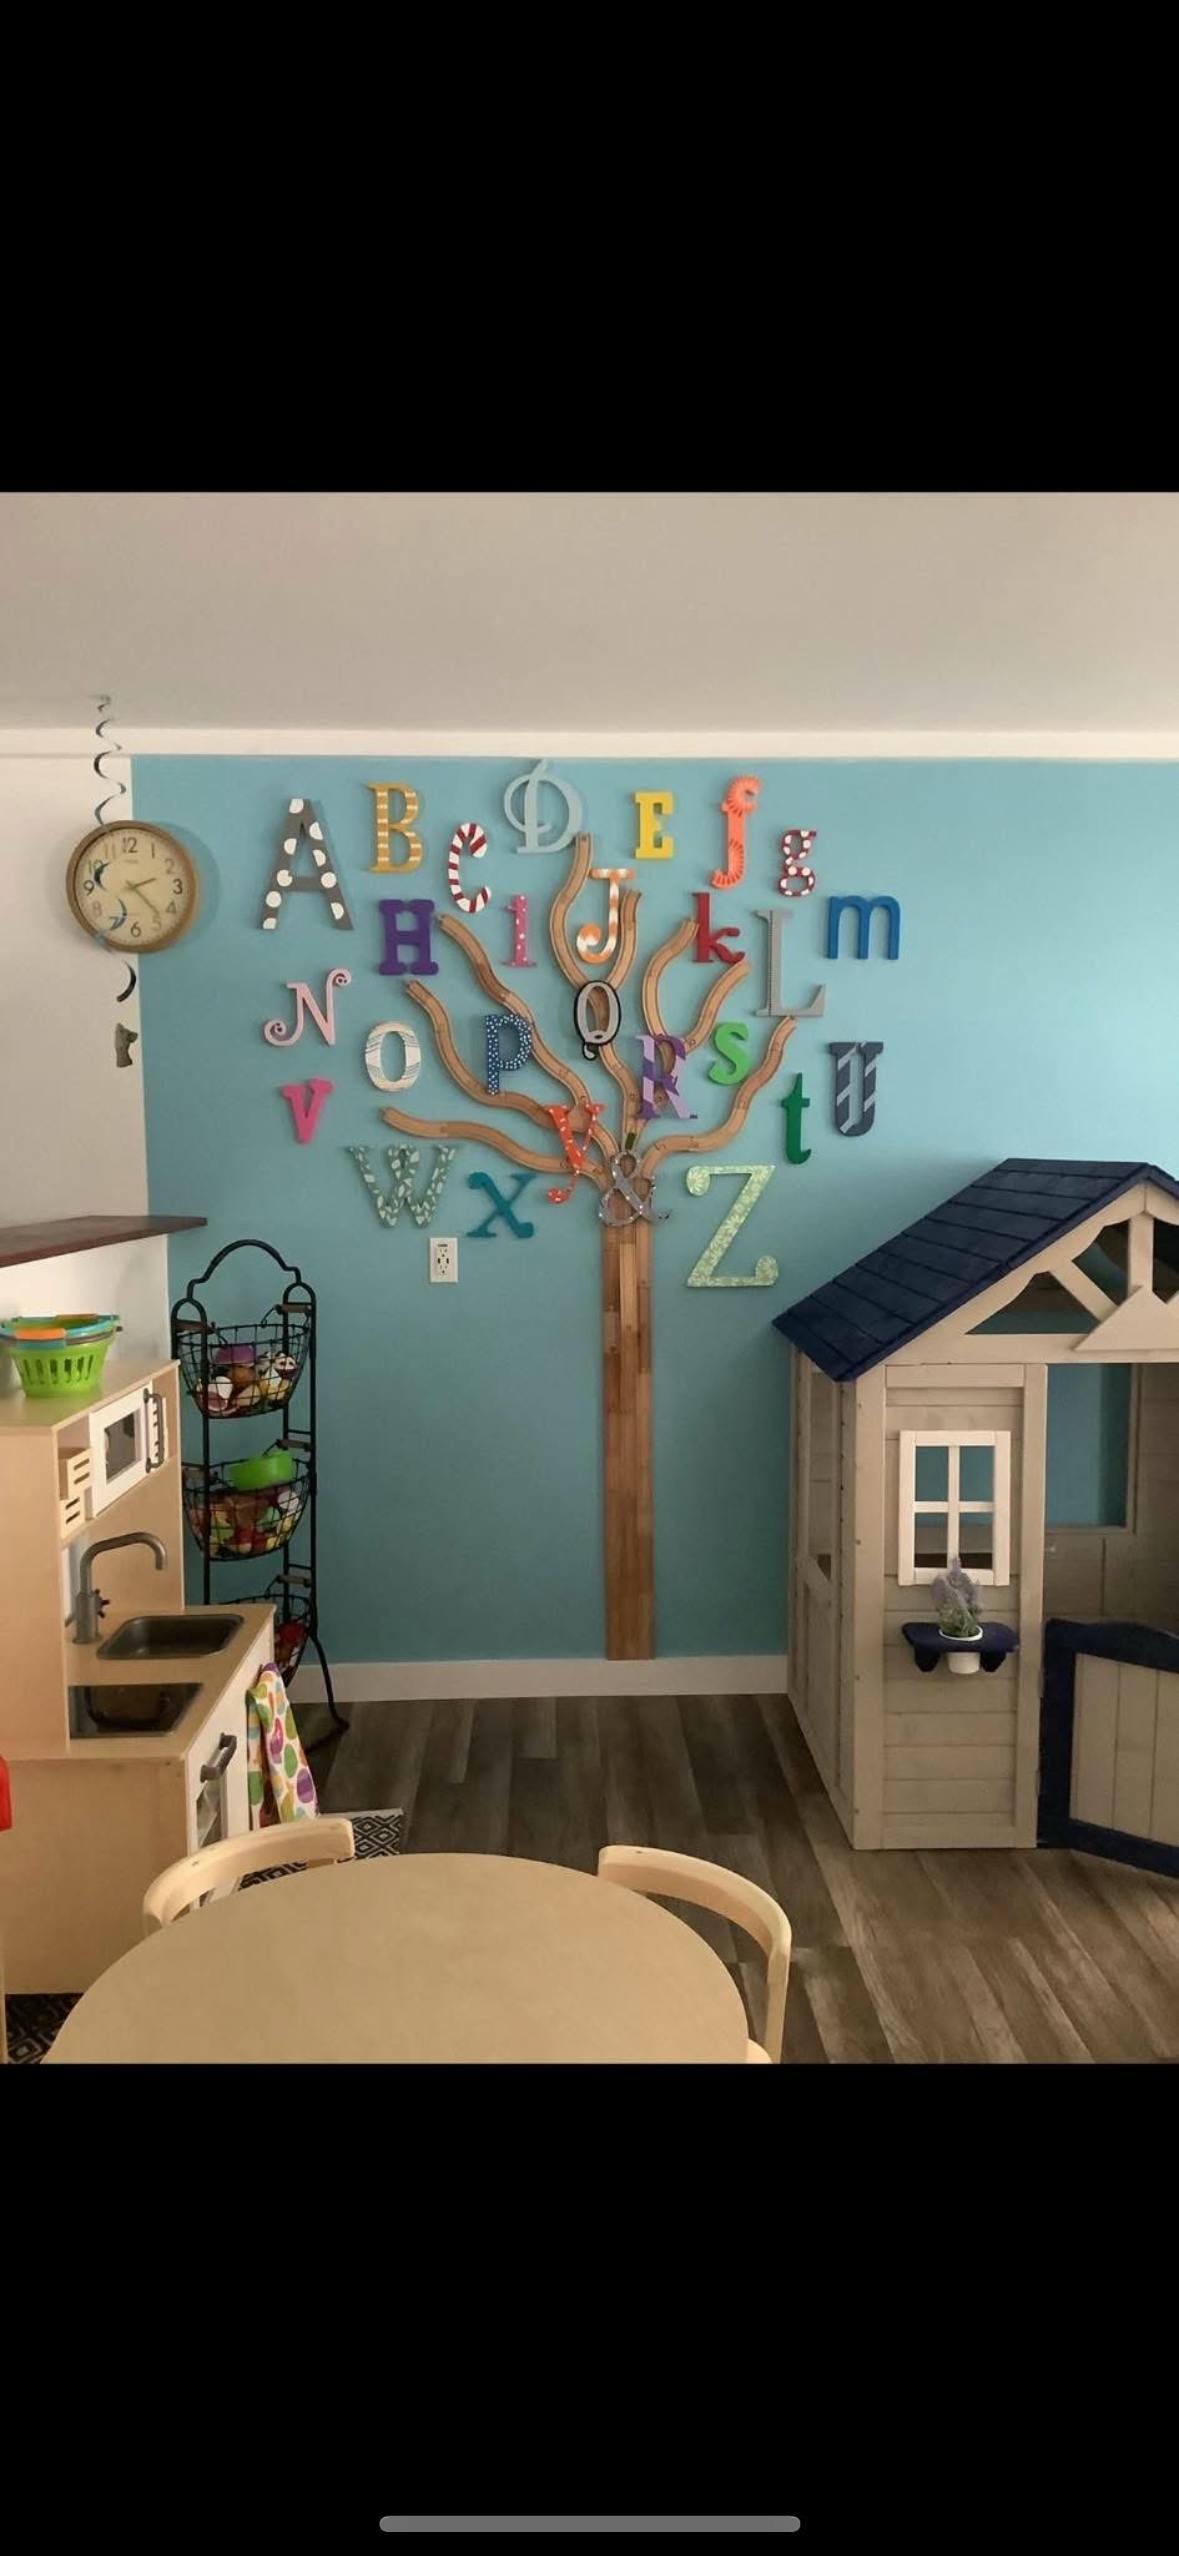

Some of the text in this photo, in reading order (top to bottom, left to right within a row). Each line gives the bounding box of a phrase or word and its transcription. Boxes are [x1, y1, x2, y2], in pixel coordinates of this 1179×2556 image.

[367, 782, 424, 873] B
[503, 759, 583, 854] D
[634, 791, 674, 859] E
[123, 837, 138, 853] 12
[164, 858, 175, 875] 2
[261, 798, 354, 930] A
[447, 822, 491, 913] C
[777, 828, 817, 897] g
[84, 880, 95, 896] 9
[165, 900, 177, 914] 4
[173, 878, 183, 895] 3
[577, 868, 635, 963] J
[130, 921, 142, 938] 6
[379, 899, 439, 975] H
[693, 892, 745, 963] k
[753, 909, 826, 1017] L
[826, 896, 901, 960] m
[263, 968, 352, 1047] N
[637, 1035, 698, 1119] R
[829, 1041, 884, 1136] U
[781, 1073, 812, 1164] t
[597, 1150, 669, 1227] &
